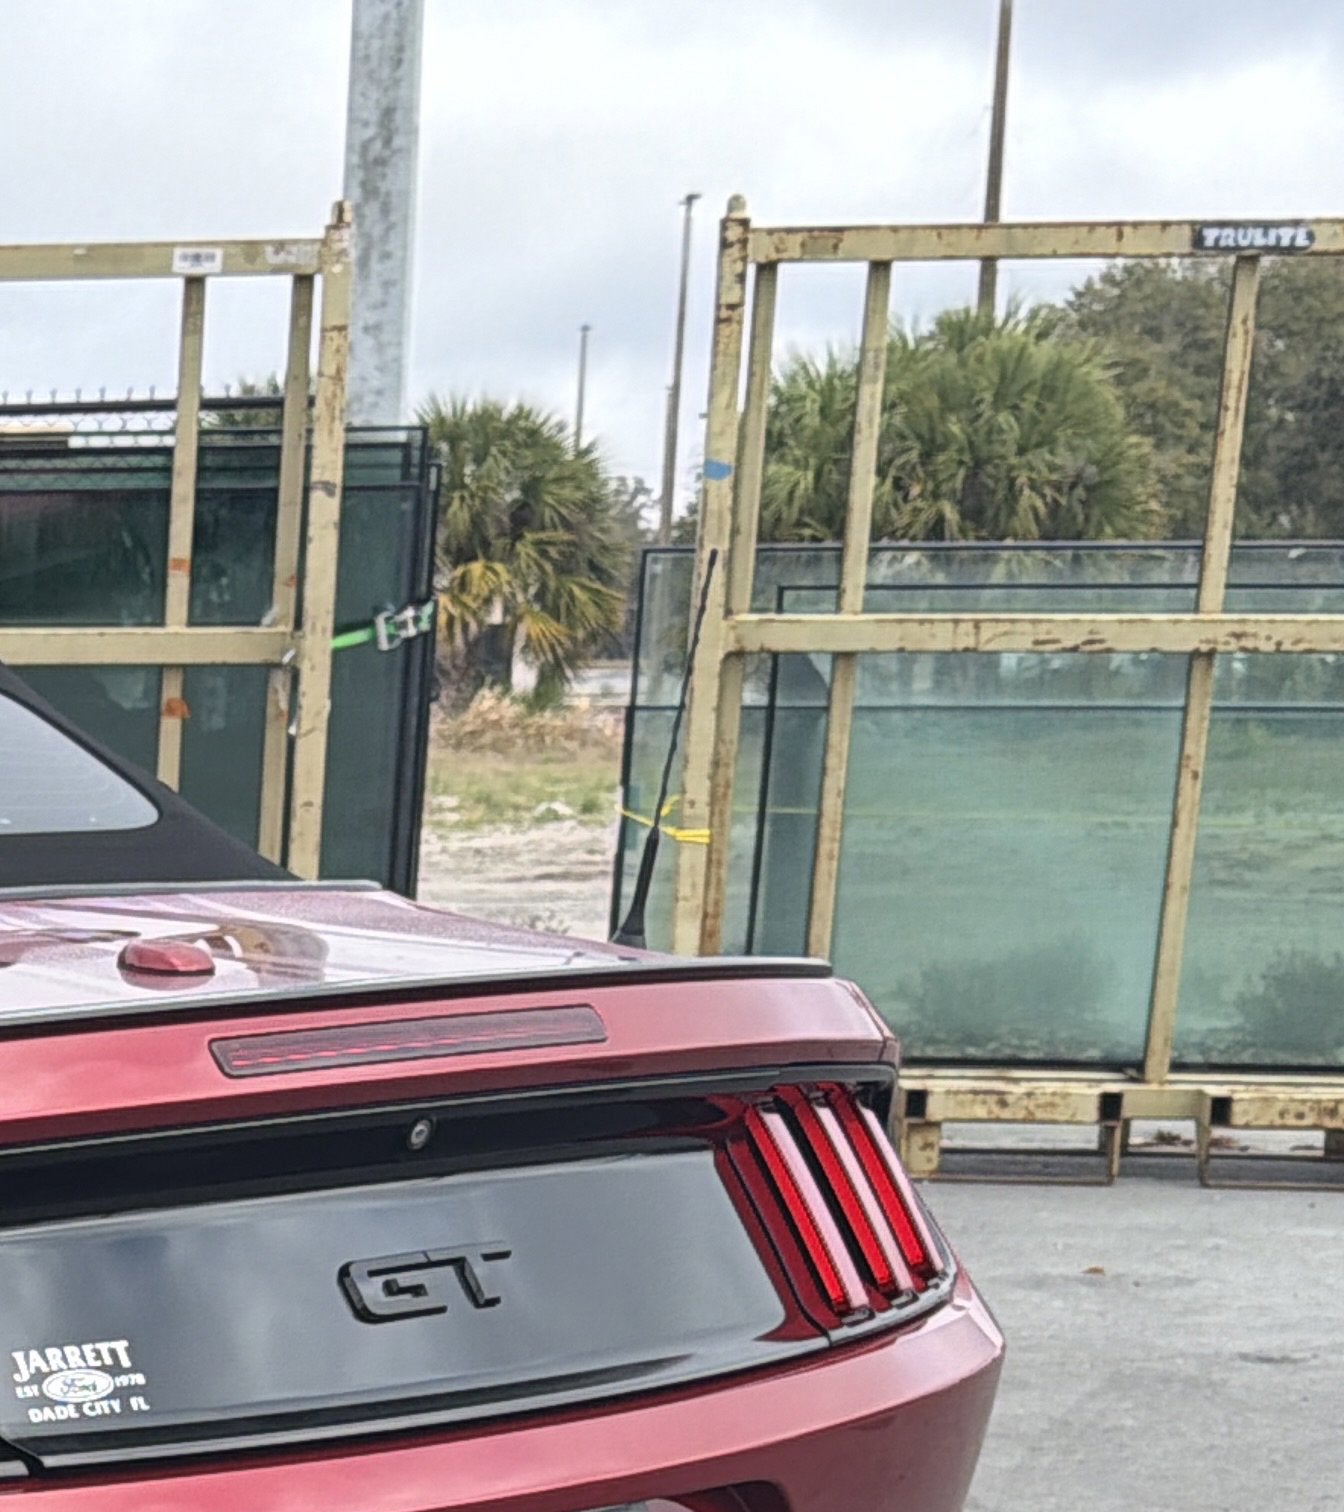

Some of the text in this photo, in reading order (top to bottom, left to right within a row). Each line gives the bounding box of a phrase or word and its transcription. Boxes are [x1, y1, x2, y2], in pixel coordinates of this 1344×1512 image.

[1202, 226, 1310, 247] TRULITE
[337, 1241, 512, 1324] GT
[11, 1340, 133, 1383] JARRETT
[28, 1396, 150, 1423] DADE CITY FL
